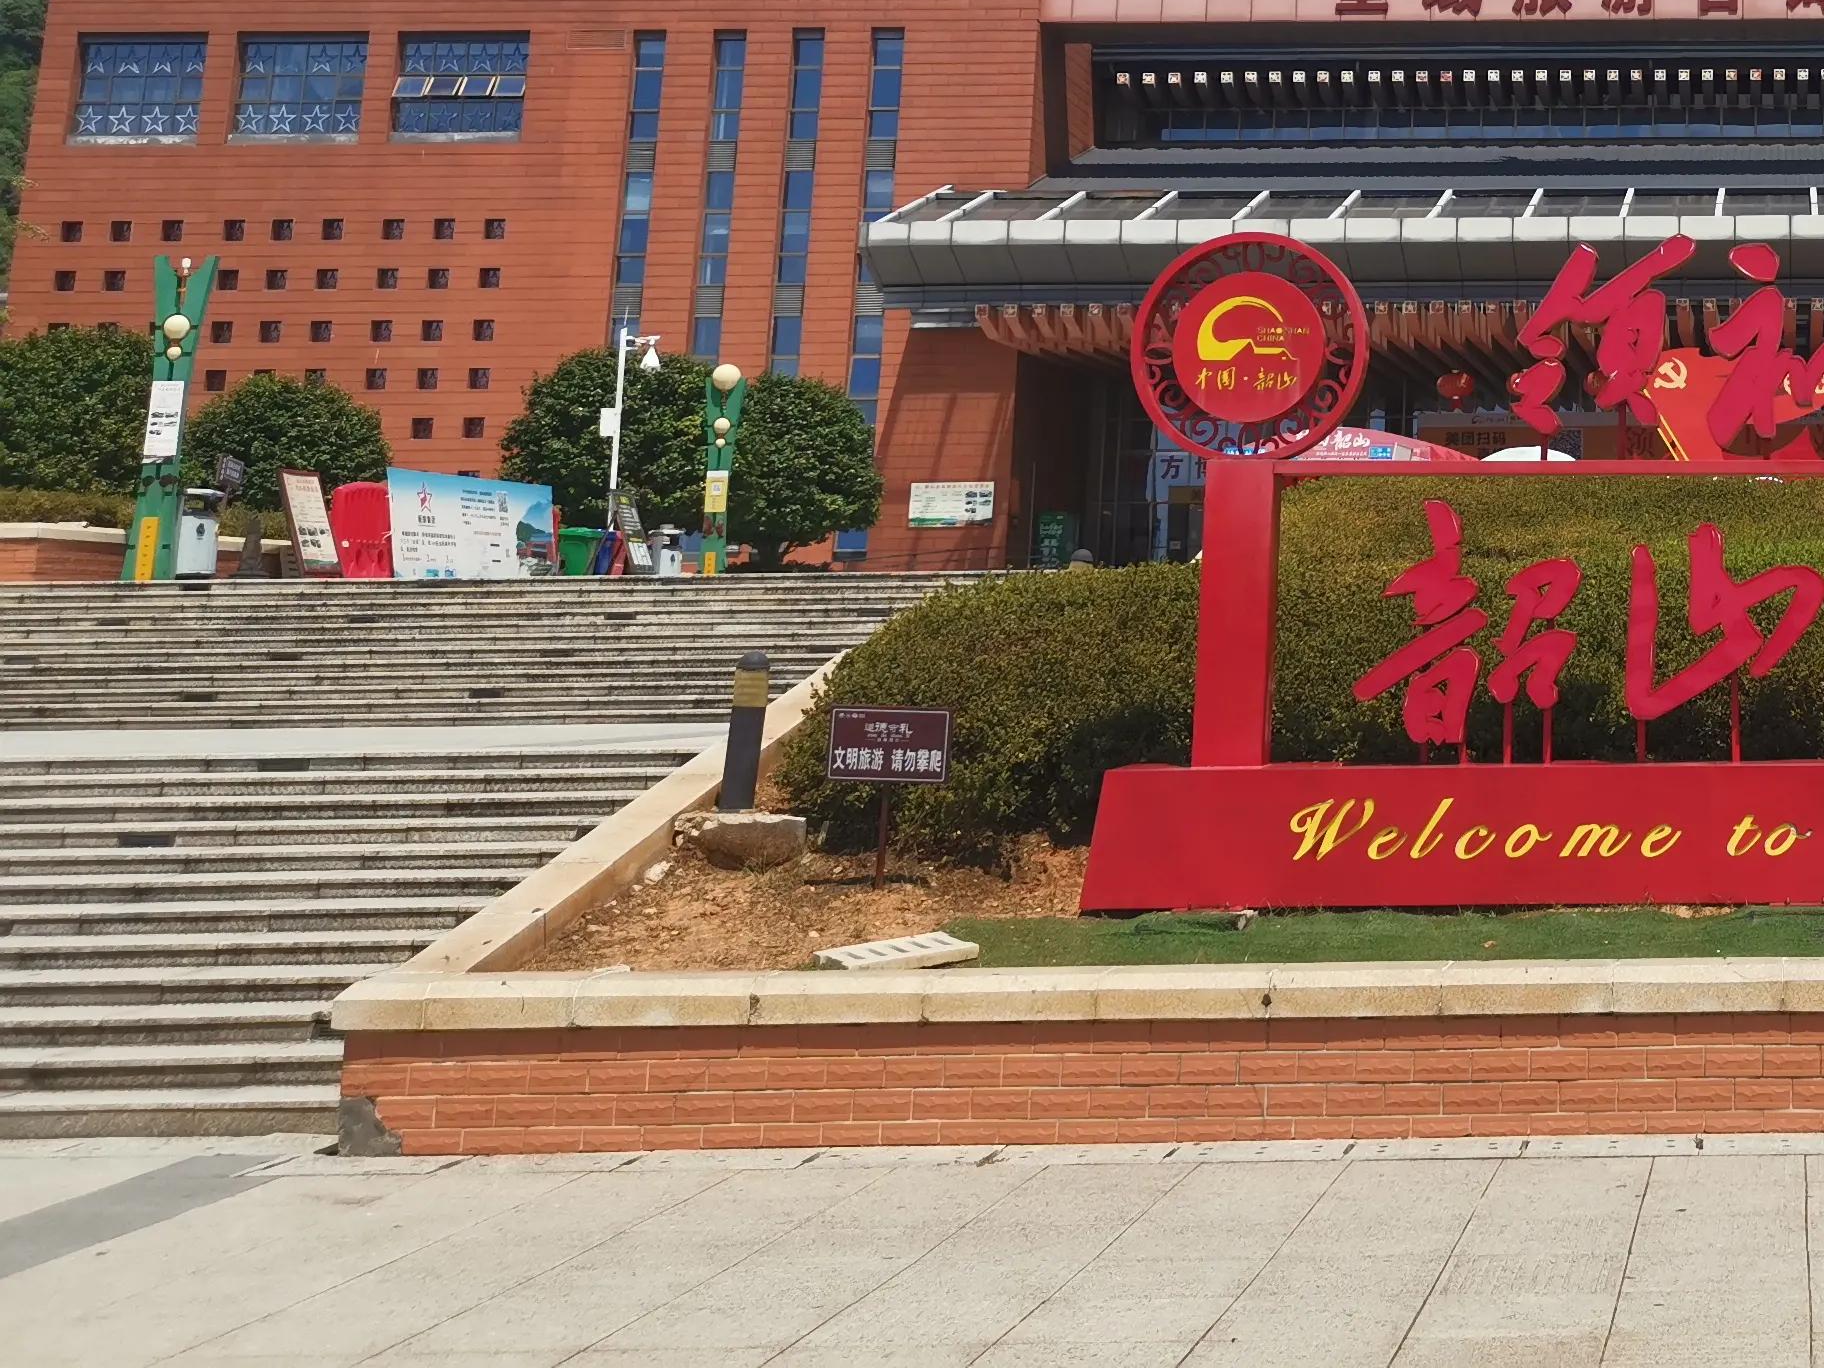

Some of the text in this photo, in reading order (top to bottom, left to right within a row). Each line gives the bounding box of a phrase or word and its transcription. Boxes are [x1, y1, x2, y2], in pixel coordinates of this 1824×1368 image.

[832, 745, 942, 773] 文明旅游 请勿攀爬
[1288, 795, 1682, 863] Welcome
[1725, 816, 1814, 858] to
